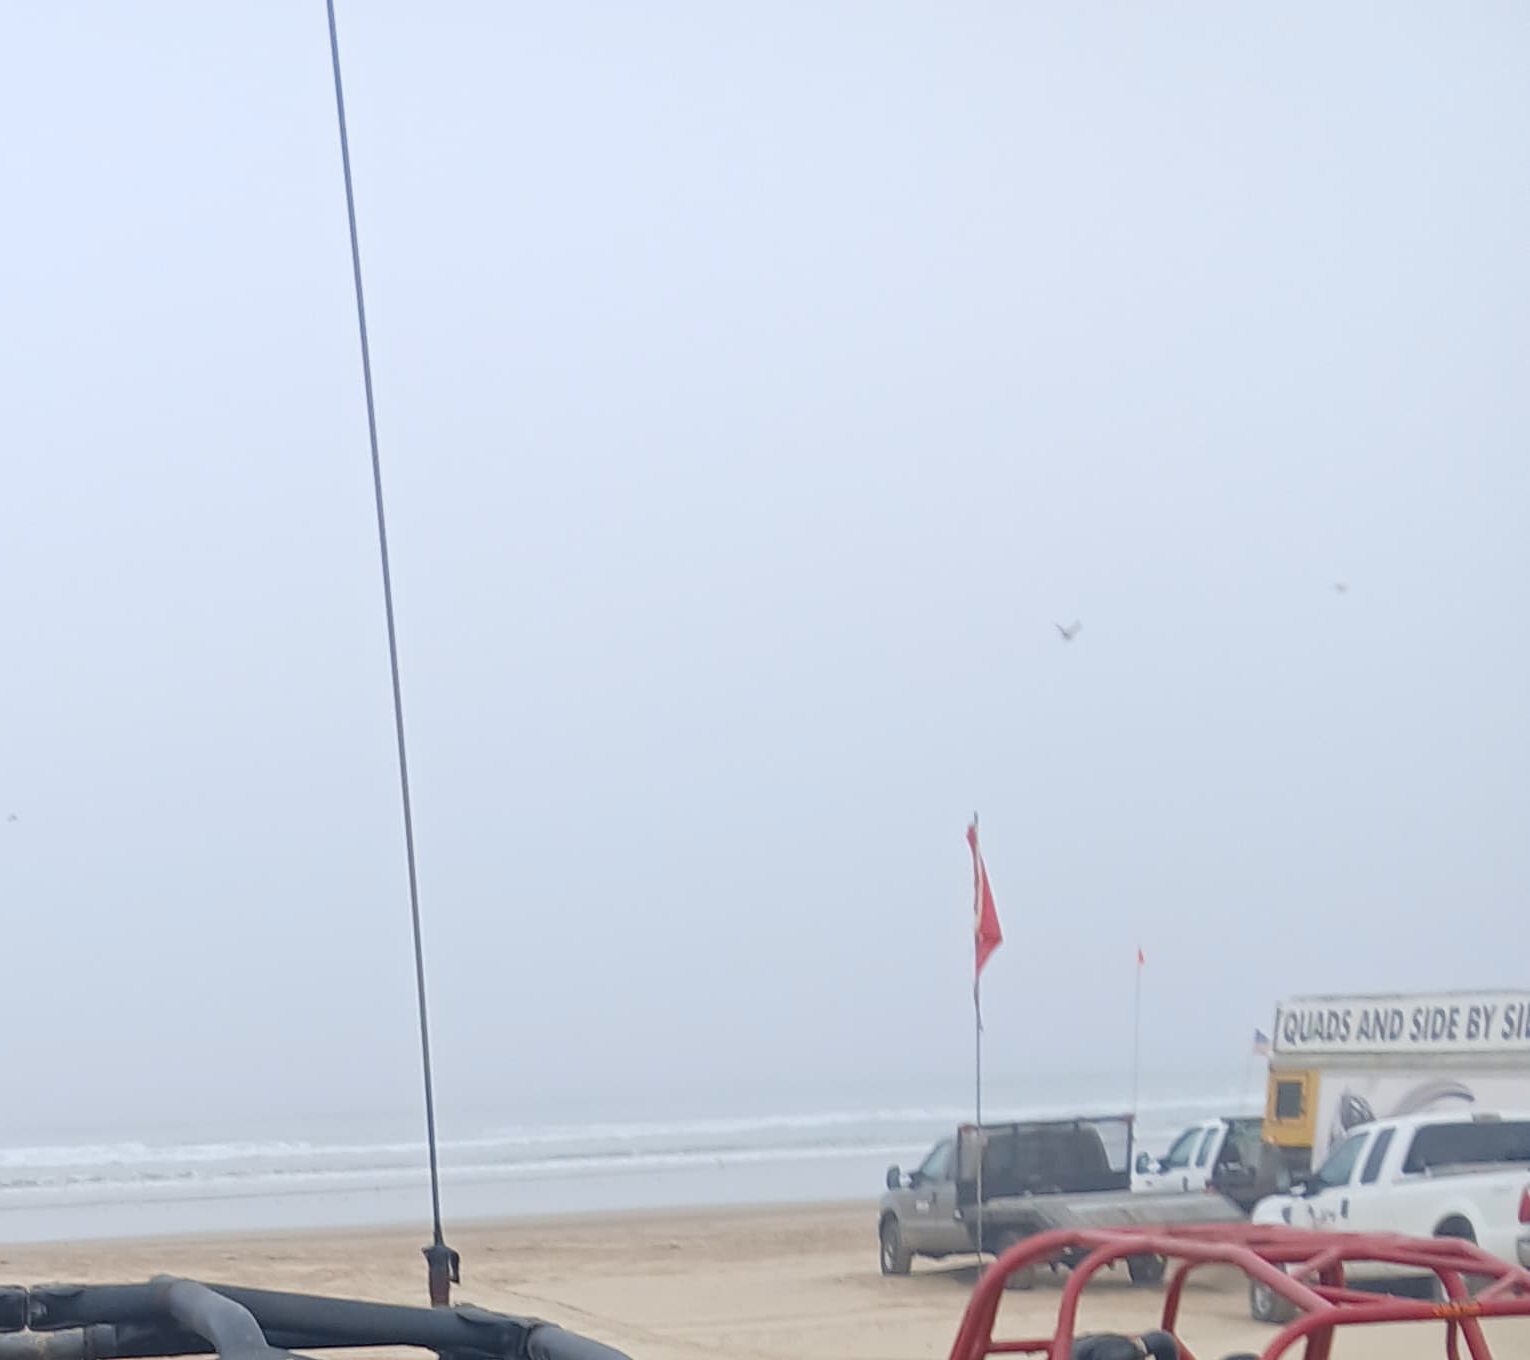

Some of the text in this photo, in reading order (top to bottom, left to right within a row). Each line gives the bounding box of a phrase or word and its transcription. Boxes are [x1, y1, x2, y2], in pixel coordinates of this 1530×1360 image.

[1283, 1008, 1352, 1046] QUADS
[1355, 1006, 1404, 1041] AND
[1409, 1005, 1460, 1042] SIDE
[1465, 1004, 1497, 1041] BY
